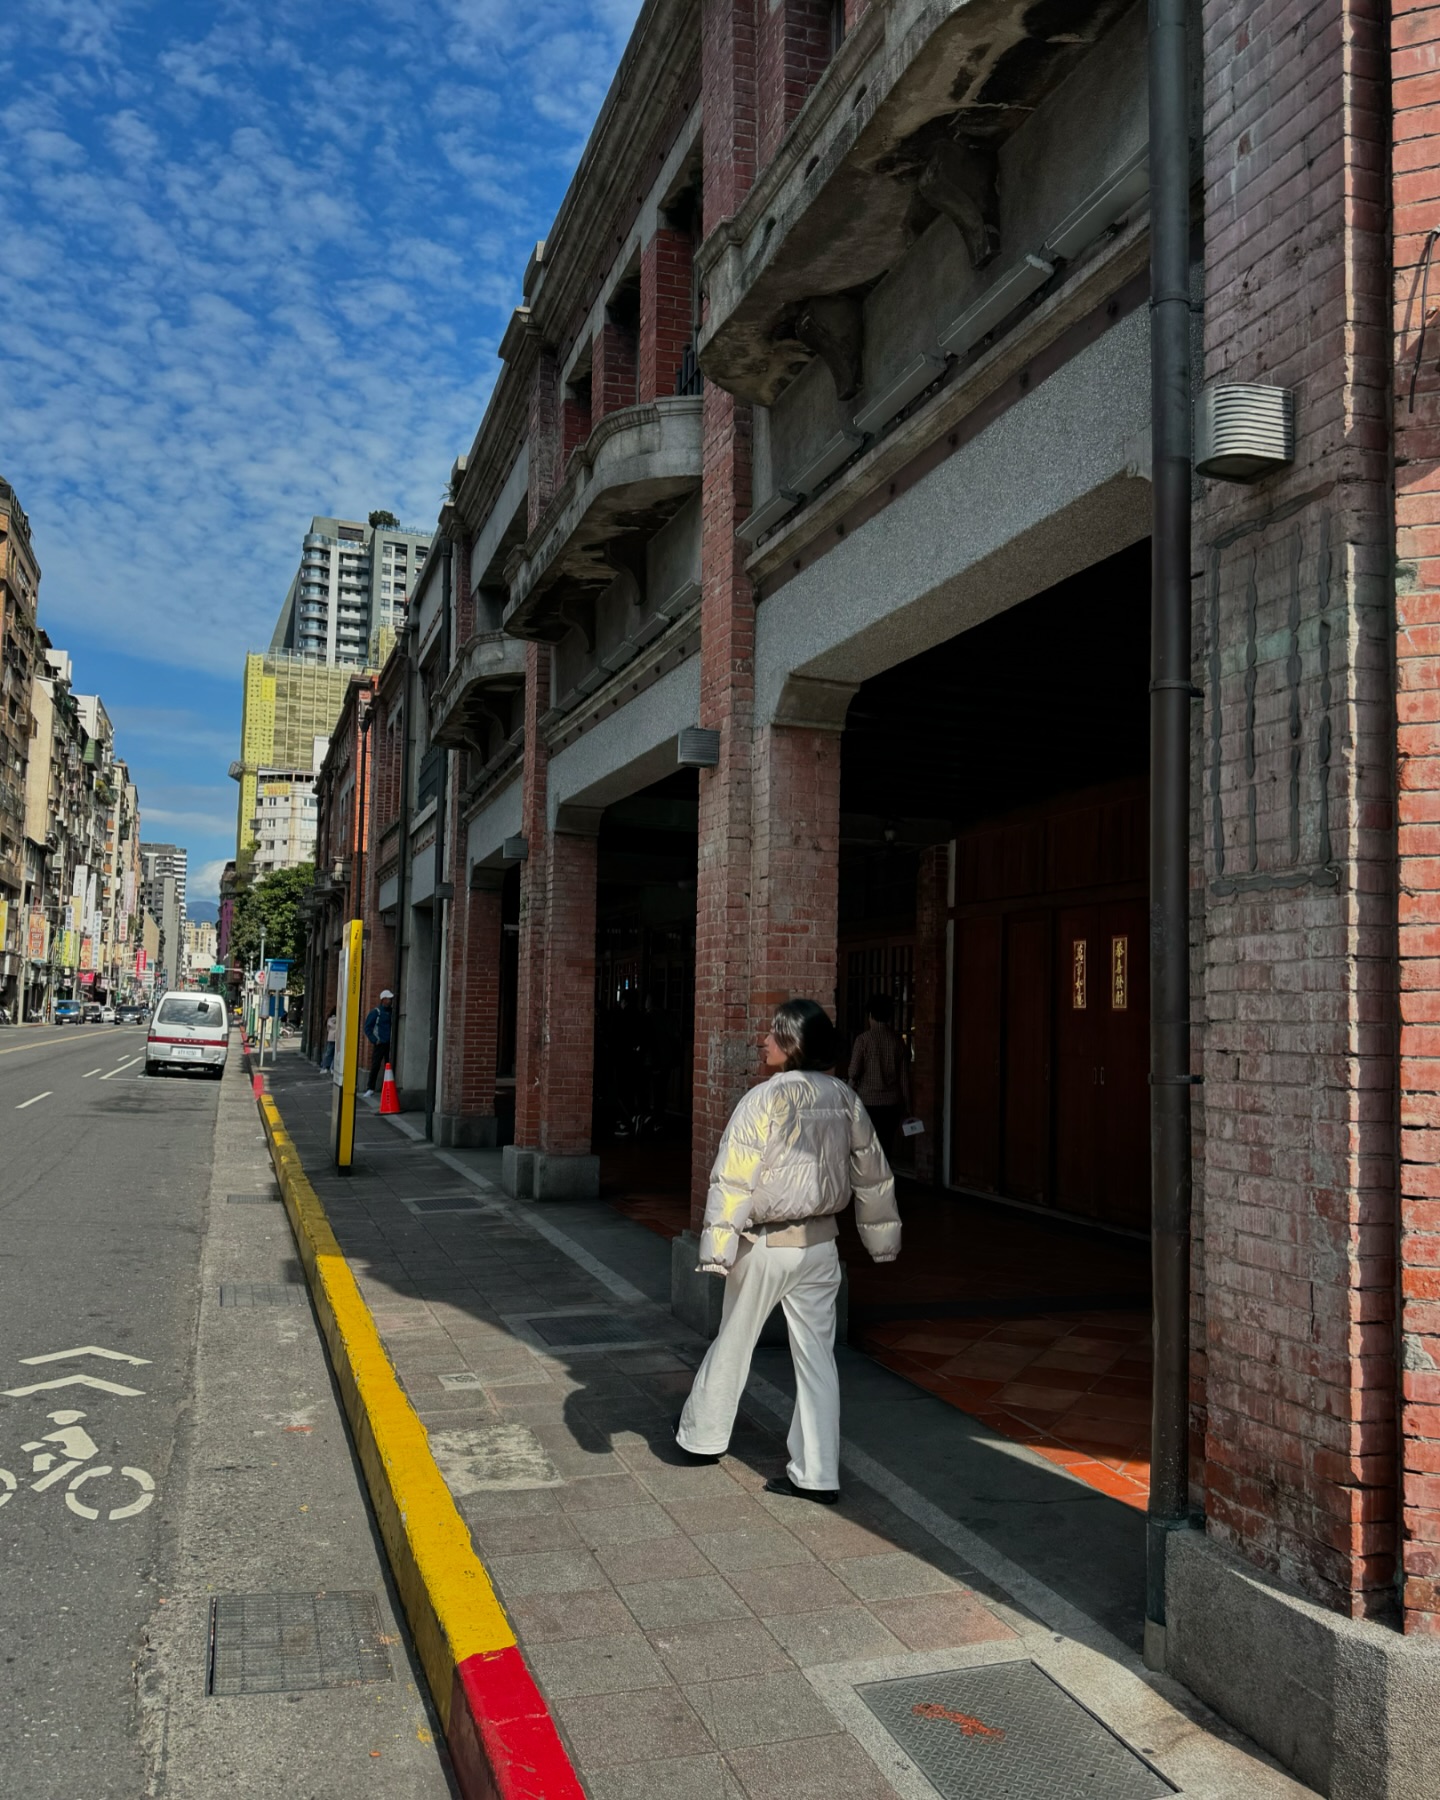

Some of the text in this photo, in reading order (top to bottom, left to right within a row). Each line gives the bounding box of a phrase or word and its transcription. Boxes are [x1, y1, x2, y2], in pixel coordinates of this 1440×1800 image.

[1075, 943, 1084, 1006] 萬事如意
[1115, 941, 1125, 1005] 恭喜發財
